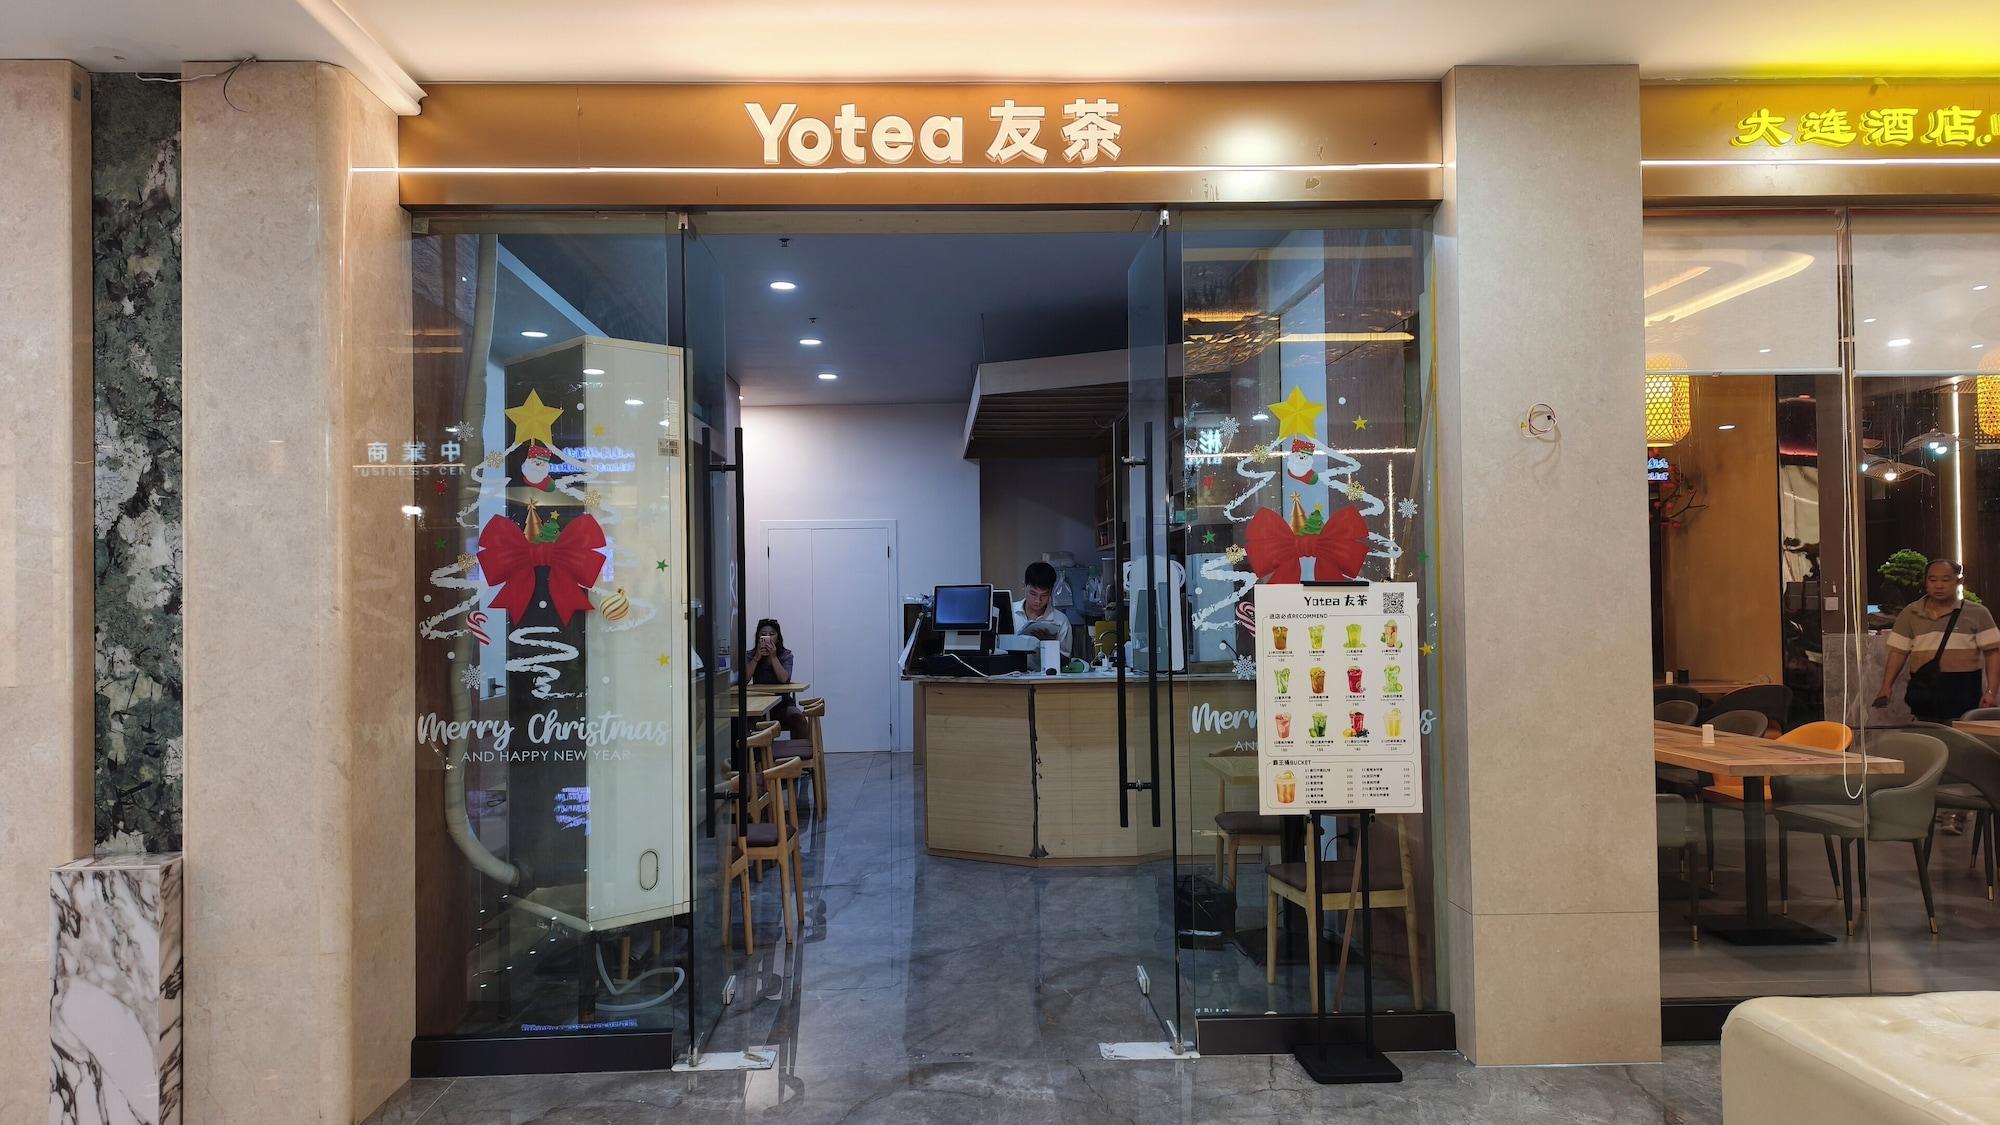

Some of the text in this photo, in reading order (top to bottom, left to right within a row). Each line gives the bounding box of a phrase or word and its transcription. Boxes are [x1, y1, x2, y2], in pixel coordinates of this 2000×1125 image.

[743, 98, 1122, 166] Yotea 友茶
[1729, 104, 2000, 148] 大连酒店
[1303, 594, 1368, 607] Yotea 友茶
[417, 711, 515, 751] Merry
[527, 708, 672, 747] Christmas
[461, 749, 631, 763] AND HAPPY NEW YEAR
[1233, 740, 1259, 752] AN
